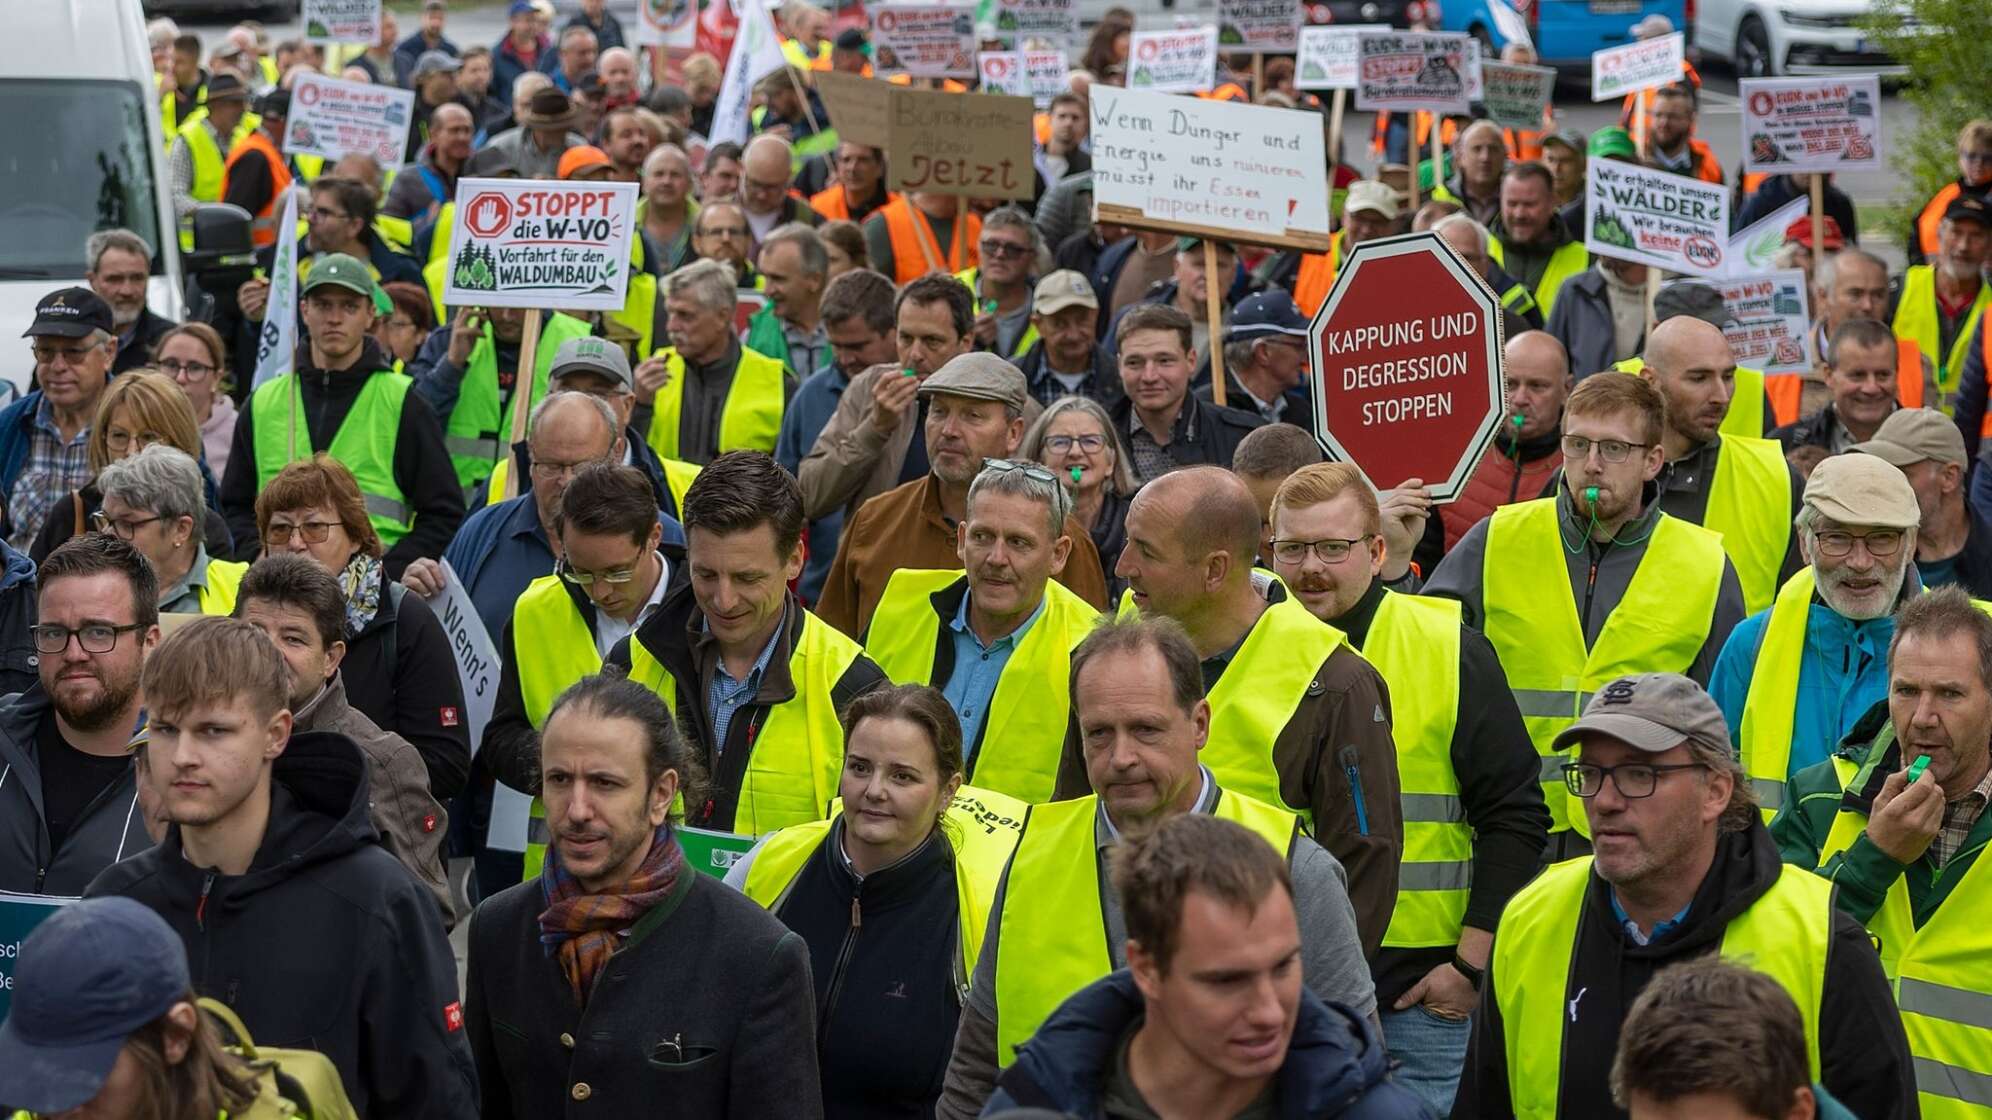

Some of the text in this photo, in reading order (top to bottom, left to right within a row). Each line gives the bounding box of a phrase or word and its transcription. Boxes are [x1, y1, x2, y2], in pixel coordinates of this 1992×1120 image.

[1091, 98, 1301, 150] Wenn Dünger und
[1091, 134, 1167, 172] Energie
[1190, 154, 1223, 167] uns
[901, 156, 1019, 190] Jetzt
[1091, 167, 1155, 186] müsst
[1173, 174, 1198, 192] ihr
[1597, 167, 1721, 203] Wir erhalten unsere
[515, 191, 616, 217] STOPPT
[1610, 184, 1706, 220] WÄLDER
[513, 218, 611, 241] die W-VO
[1631, 215, 1716, 238] Wir brauchen
[1640, 230, 1681, 247] keine
[499, 247, 605, 263] Vorfahrt für den
[499, 265, 597, 285] WALDUMBAU
[1329, 311, 1478, 355] KAPPUNG UND
[1343, 351, 1468, 391] DEGRESSION
[1363, 391, 1452, 426] STOPPEN
[442, 595, 489, 697] Wenn's
